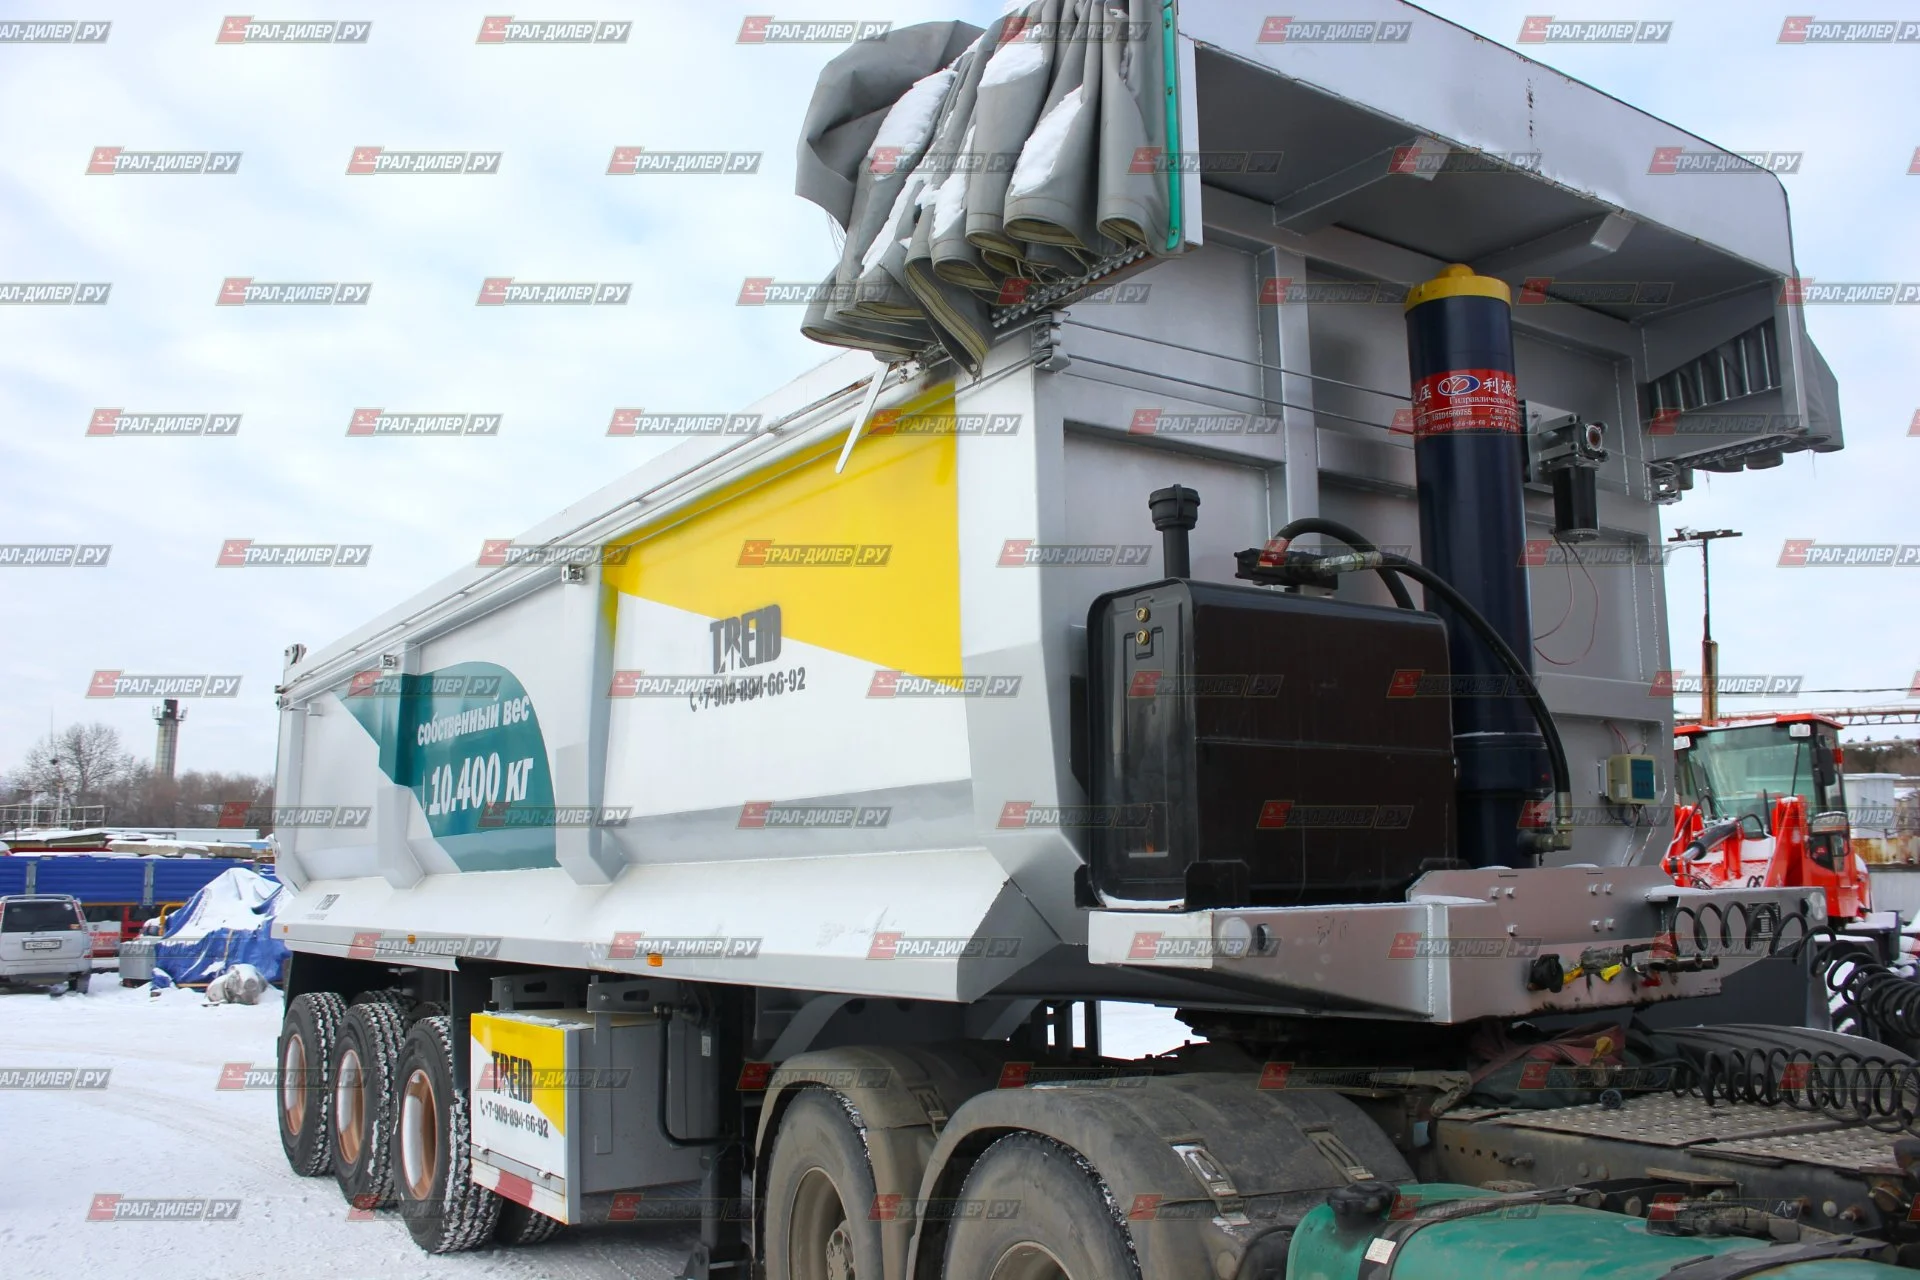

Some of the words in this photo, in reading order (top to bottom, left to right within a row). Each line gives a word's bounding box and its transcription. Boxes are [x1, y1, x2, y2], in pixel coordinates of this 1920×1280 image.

[417, 693, 500, 746] собственный
[502, 696, 530, 726] вес
[428, 752, 501, 816] 10.400
[485, 1100, 549, 1138] +7-909-894-66-92
